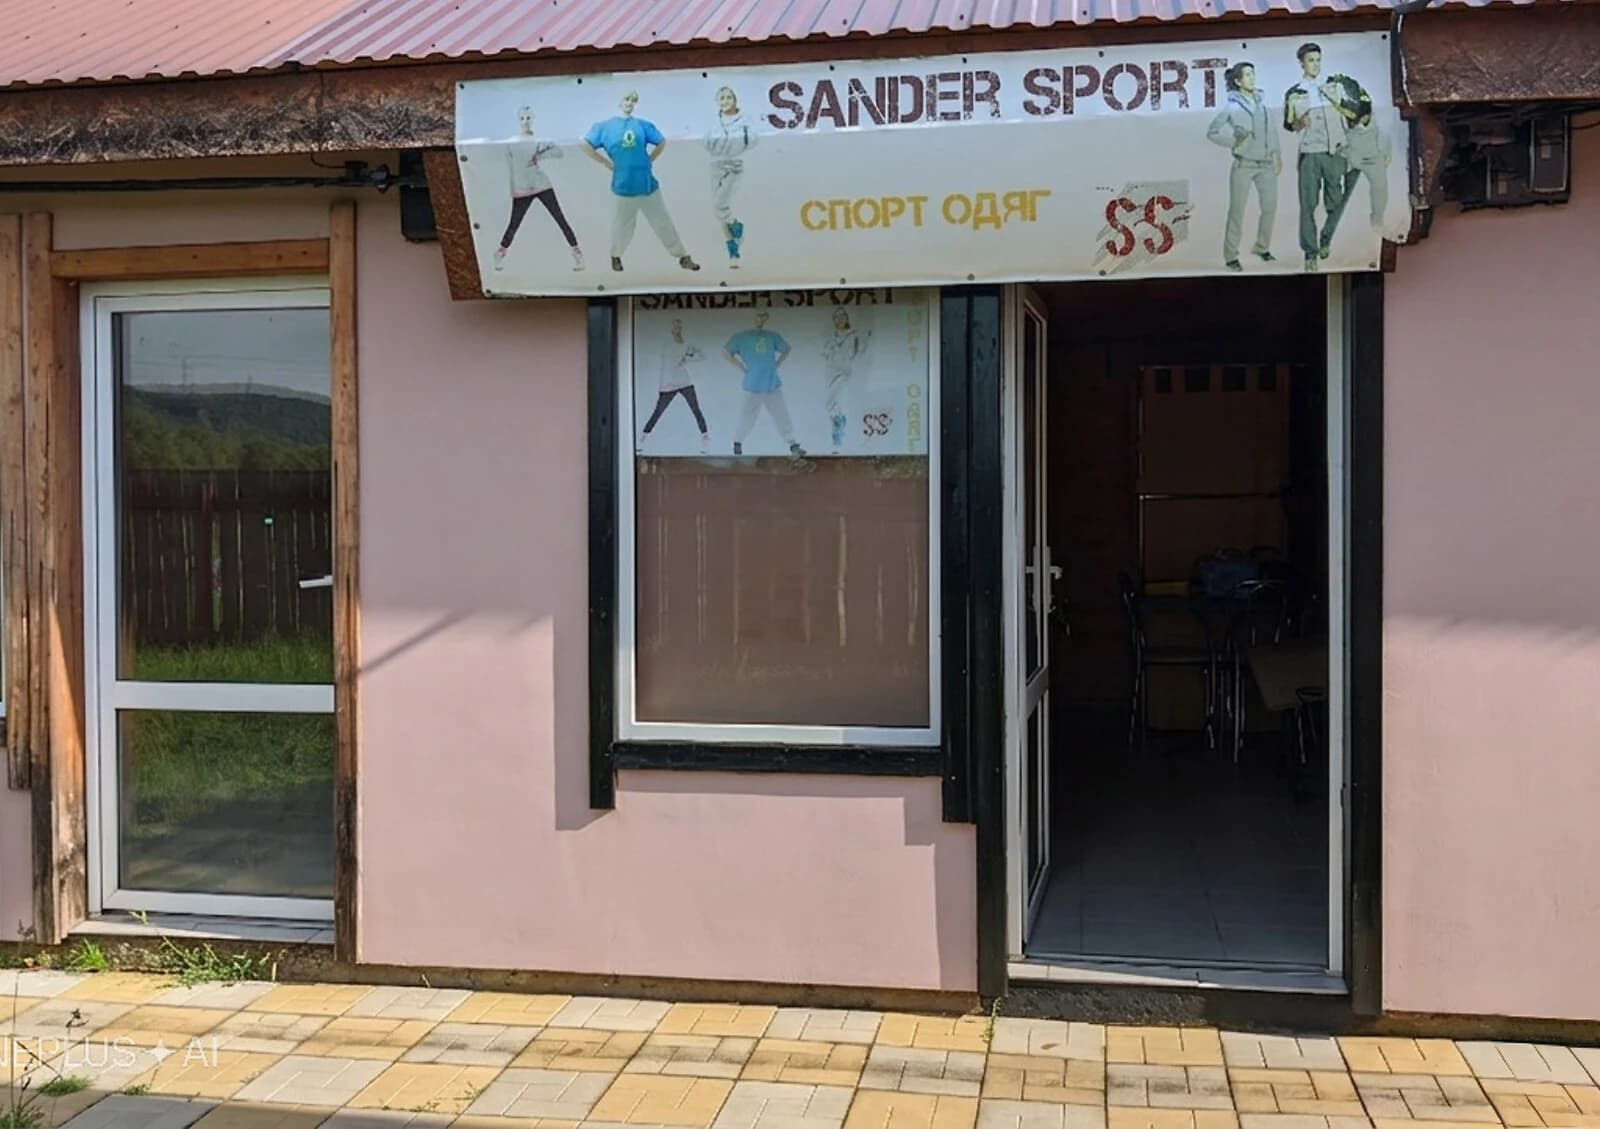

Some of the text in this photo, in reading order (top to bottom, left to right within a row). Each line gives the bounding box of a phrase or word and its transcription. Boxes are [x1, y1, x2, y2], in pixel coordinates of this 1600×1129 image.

[768, 57, 1228, 129] SANDER SPORT
[800, 190, 1051, 231] СПОРТ ОДЯГ
[1106, 195, 1174, 256] SS
